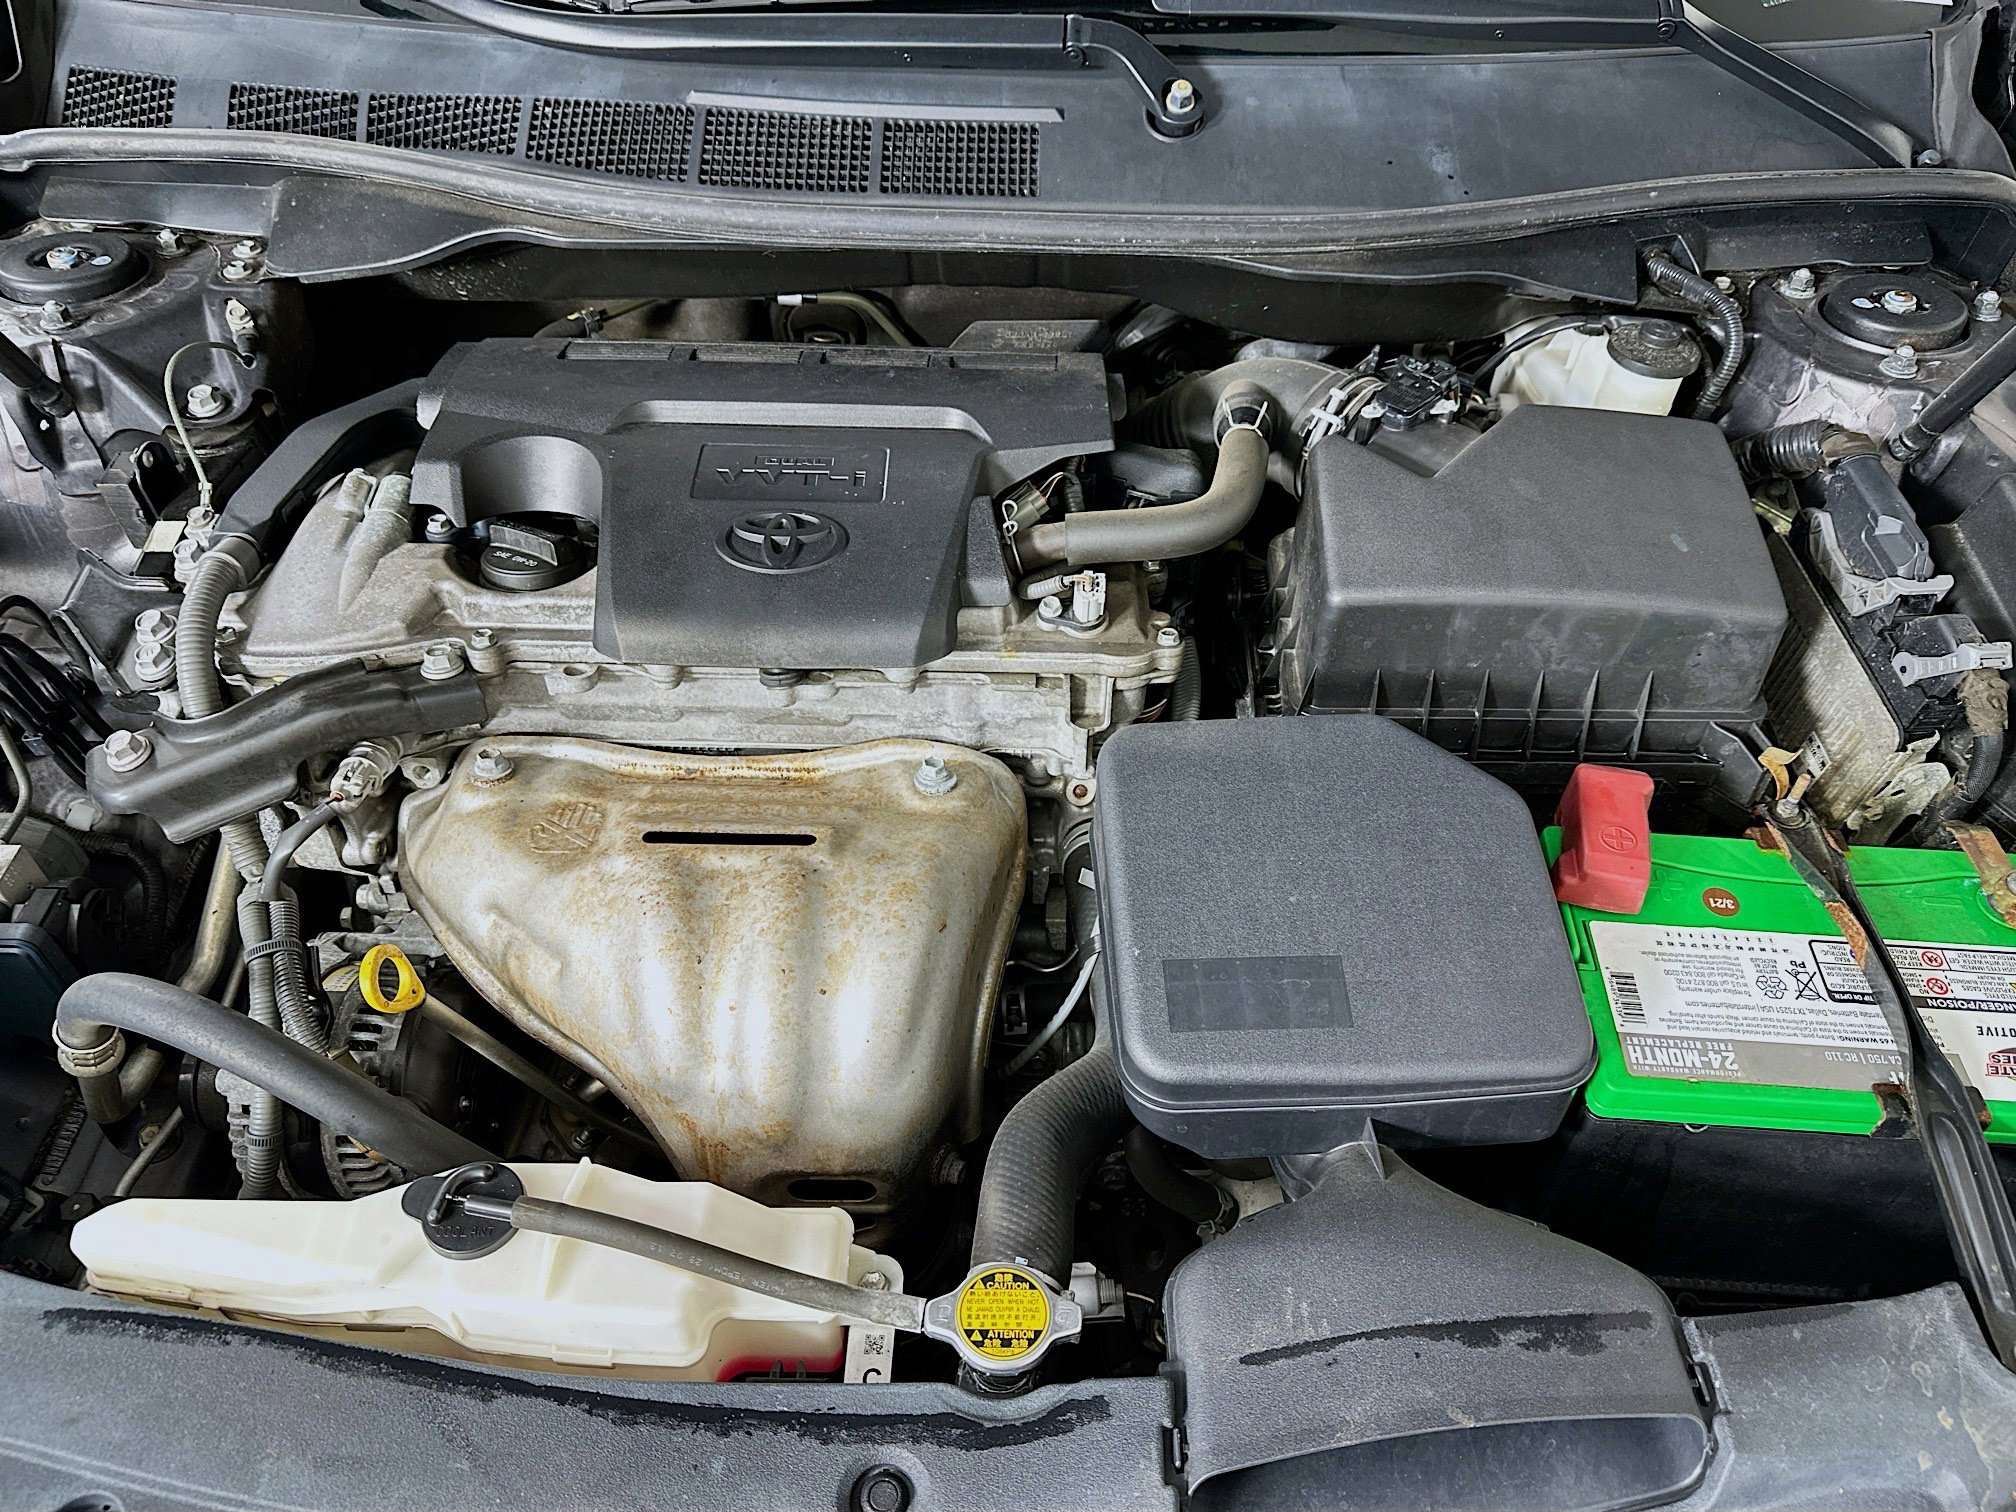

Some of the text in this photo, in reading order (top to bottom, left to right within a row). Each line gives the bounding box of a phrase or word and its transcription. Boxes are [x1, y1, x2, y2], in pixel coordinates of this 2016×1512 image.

[765, 456, 827, 466] DUAL
[493, 550, 538, 567] SAE 0W-20
[1708, 897, 1736, 910] 3/21
[1749, 957, 1777, 965] RECYCLED
[1789, 960, 1807, 969] Pb
[1717, 972, 1739, 980] Canada
[1722, 987, 1743, 995] replace
[1684, 1000, 1756, 1012] interstatebatteries.com
[1761, 1005, 1774, 1013] USA
[1776, 1007, 1797, 1015] 75251
[1806, 1007, 1827, 1017] Dallas,
[1828, 1008, 1859, 1018] Batteries,
[1699, 1019, 1733, 1027] reproductive
[1772, 1030, 1799, 1038] terminals
[1976, 1025, 2016, 1038] OTIVE
[1816, 1033, 1835, 1041] Battery
[1836, 1035, 1878, 1044] WARNING:
[1625, 1036, 1733, 1051] FREE REPLACEMENT
[1626, 1044, 1739, 1070] 24-MONTH
[1824, 1051, 1842, 1061] 110
[1843, 1052, 1858, 1062] RC
[1867, 1053, 1887, 1065] 750
[1653, 1065, 1690, 1075] WARRANTY
[1692, 1068, 1741, 1077] PERFORMANCE
[435, 1225, 495, 1238] COOLANT
[752, 1278, 784, 1296] WATER
[986, 1281, 1030, 1290] CAUTION
[987, 1329, 1035, 1339] ATTENTION
